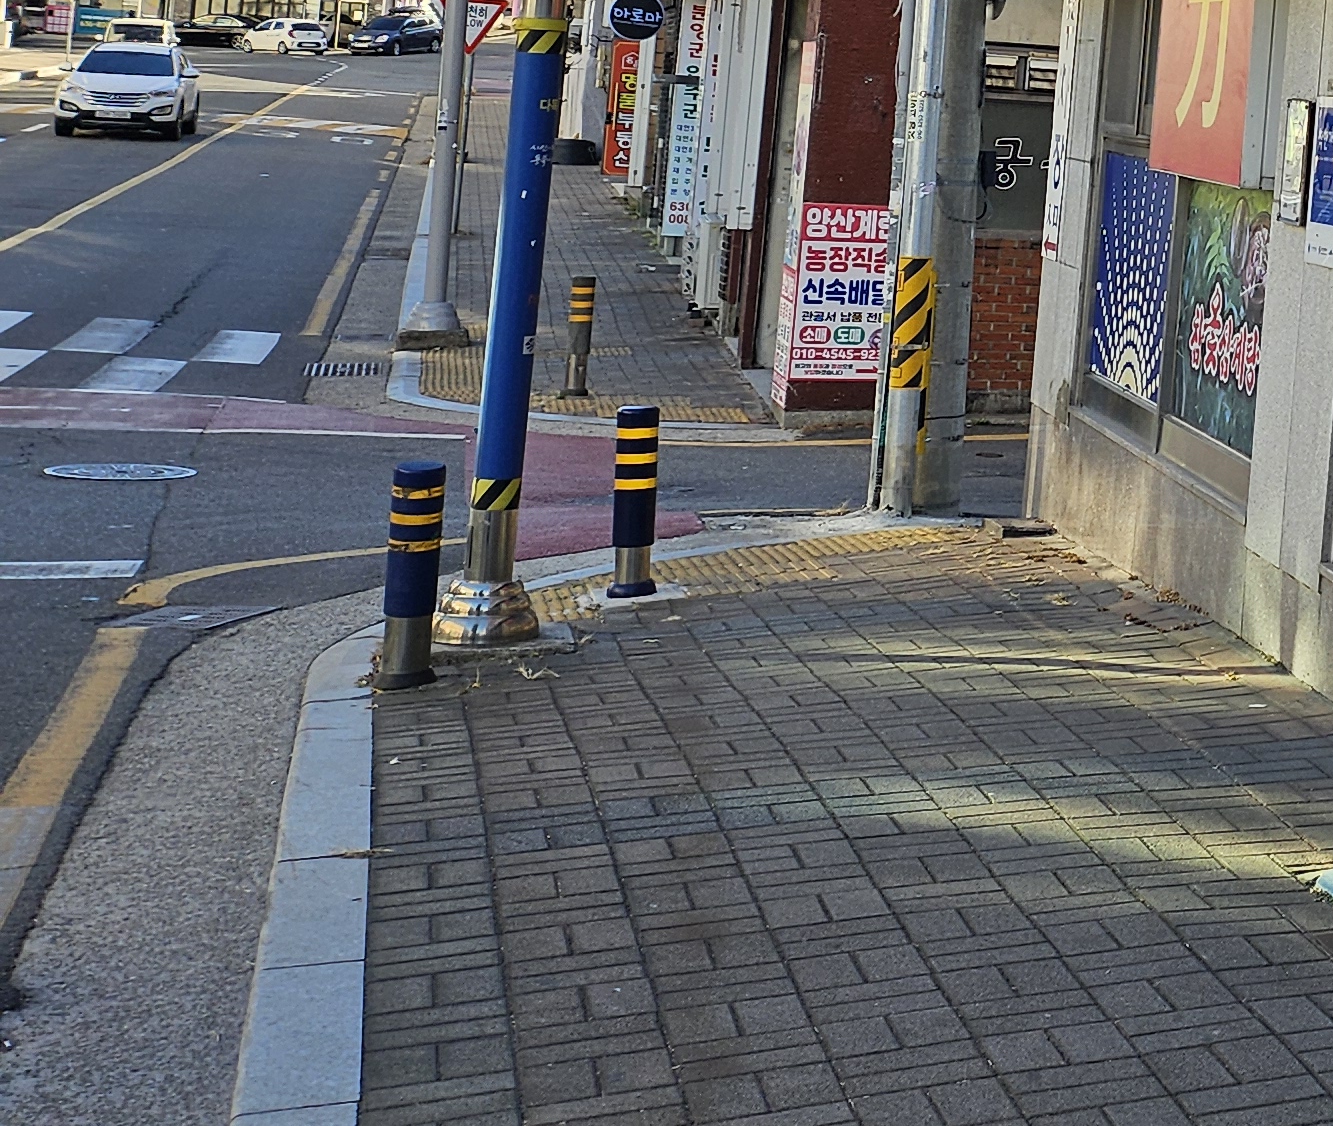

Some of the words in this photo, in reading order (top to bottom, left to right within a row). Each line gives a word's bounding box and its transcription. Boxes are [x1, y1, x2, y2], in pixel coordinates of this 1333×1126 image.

[467, 5, 489, 19] 천히
[613, 7, 663, 23] 아로마
[802, 311, 836, 323] 관공서
[840, 312, 862, 323] 납품
[802, 327, 827, 343] 소매
[837, 328, 861, 343] 도매
[793, 348, 880, 360] 010-4545-923
